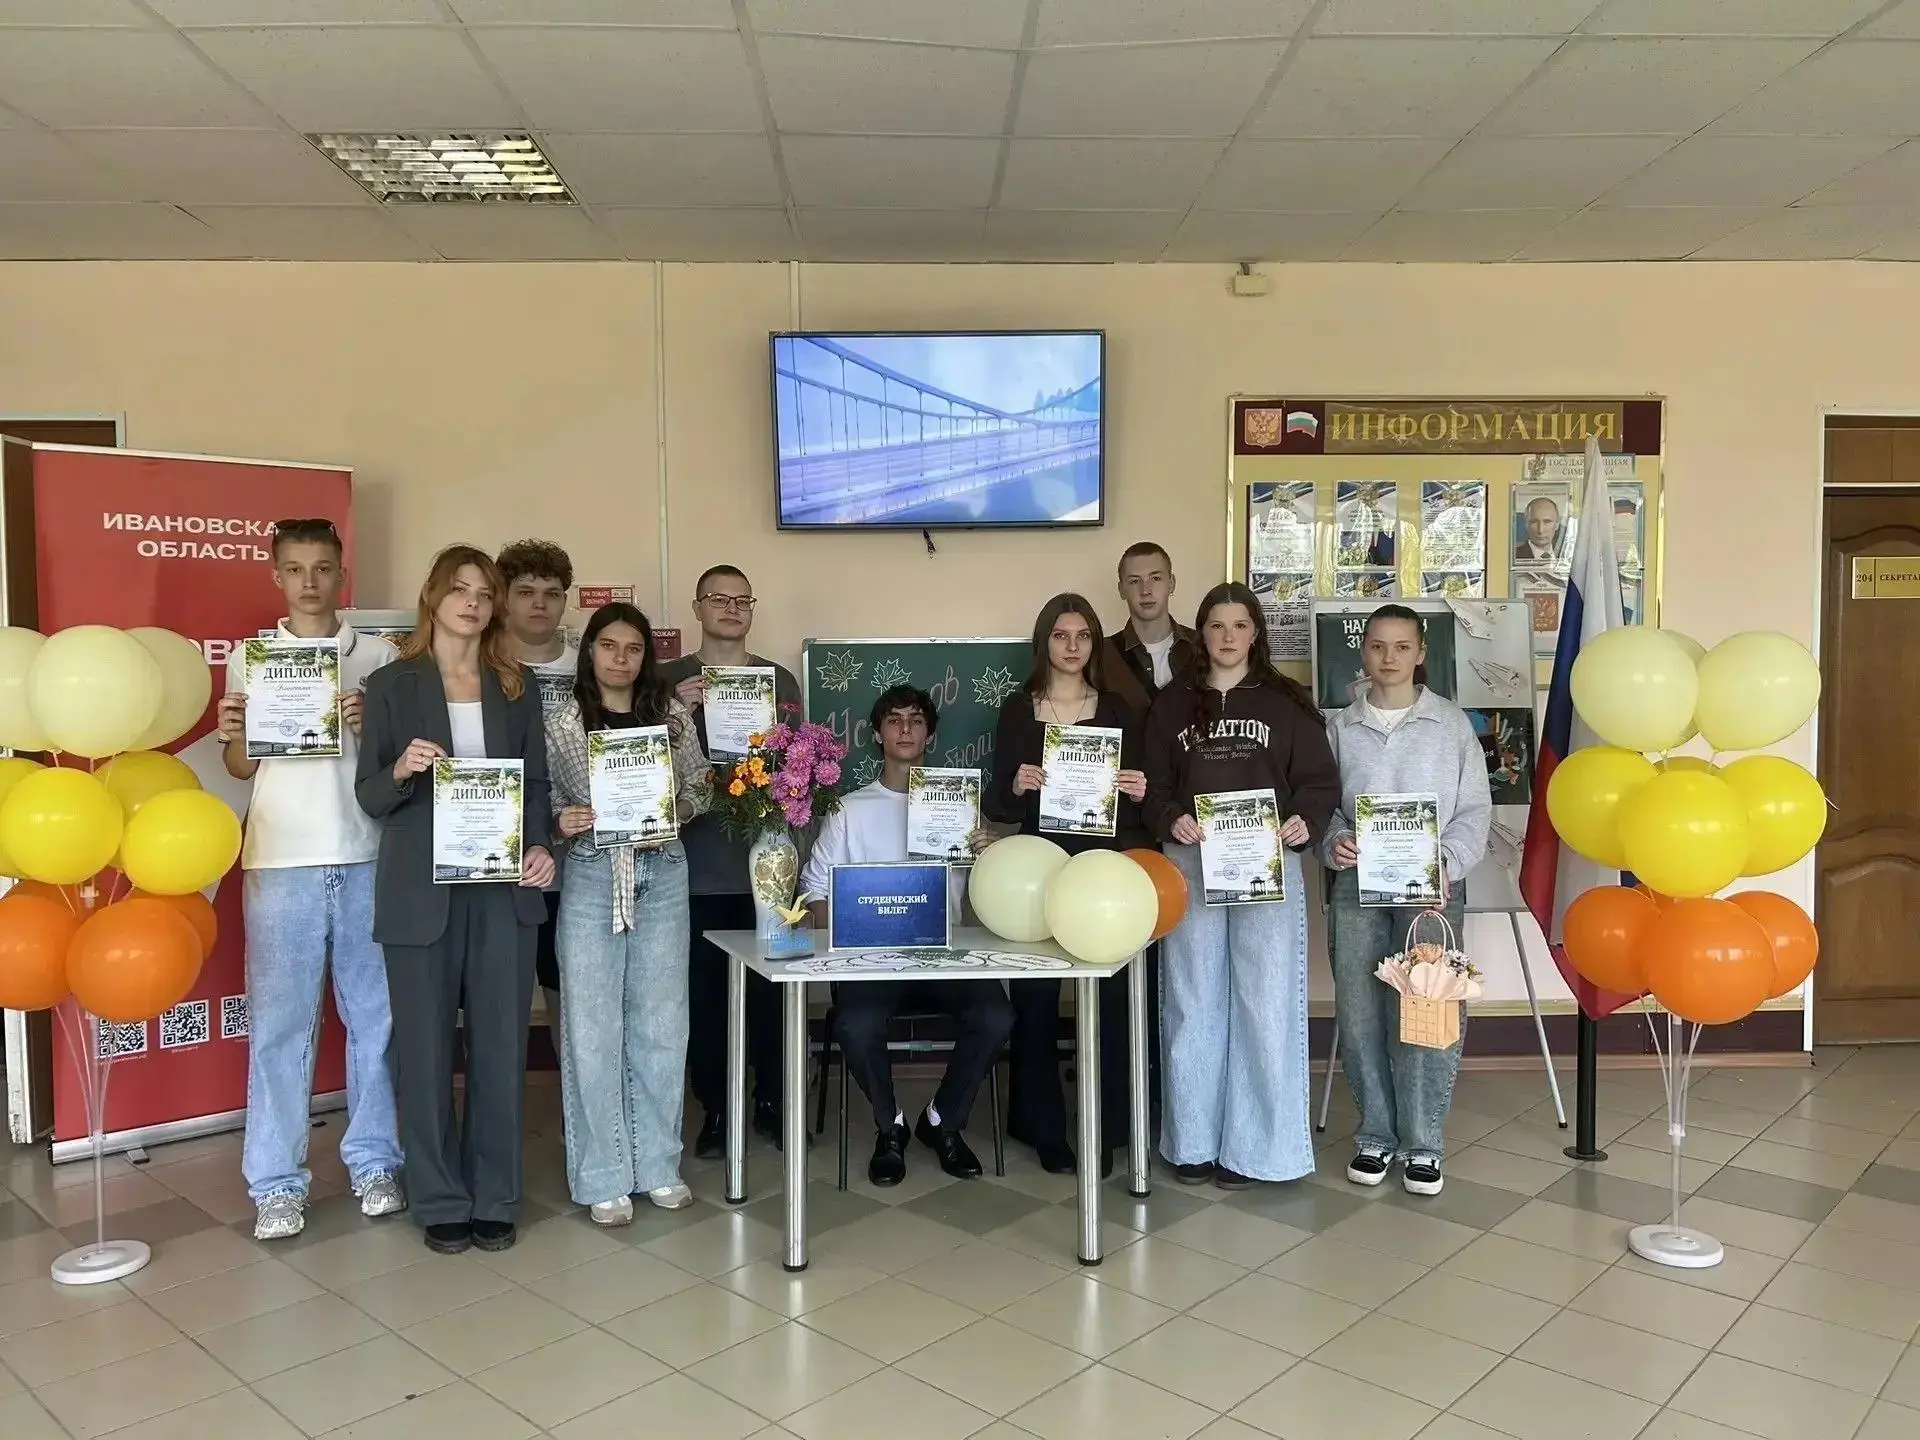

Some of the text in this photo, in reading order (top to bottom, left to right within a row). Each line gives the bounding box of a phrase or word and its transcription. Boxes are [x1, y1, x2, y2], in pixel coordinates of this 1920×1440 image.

[1332, 410, 1616, 442] ИНФОРМАЦИЯ
[102, 512, 277, 537] ИВАНОВСКА
[136, 539, 270, 562] ОБЛАСТЬ
[1856, 573, 1873, 582] 204
[263, 667, 323, 680] ДИПЛОМ
[717, 690, 762, 701] ДИПЛОМ
[1177, 719, 1271, 752] TATION
[604, 754, 656, 770] ДИПЛОМ
[1057, 751, 1106, 764] ДИПЛОМ
[450, 788, 506, 801] ДИПЛОМ
[922, 791, 967, 802] ДИПЛОМ
[1214, 817, 1264, 832] ДИПЛОМ
[1371, 820, 1424, 832] ДИПЛОМ
[857, 893, 927, 905] СТУДЕНЧЕСКИЙ
[877, 906, 908, 915] БИЛЕТ
